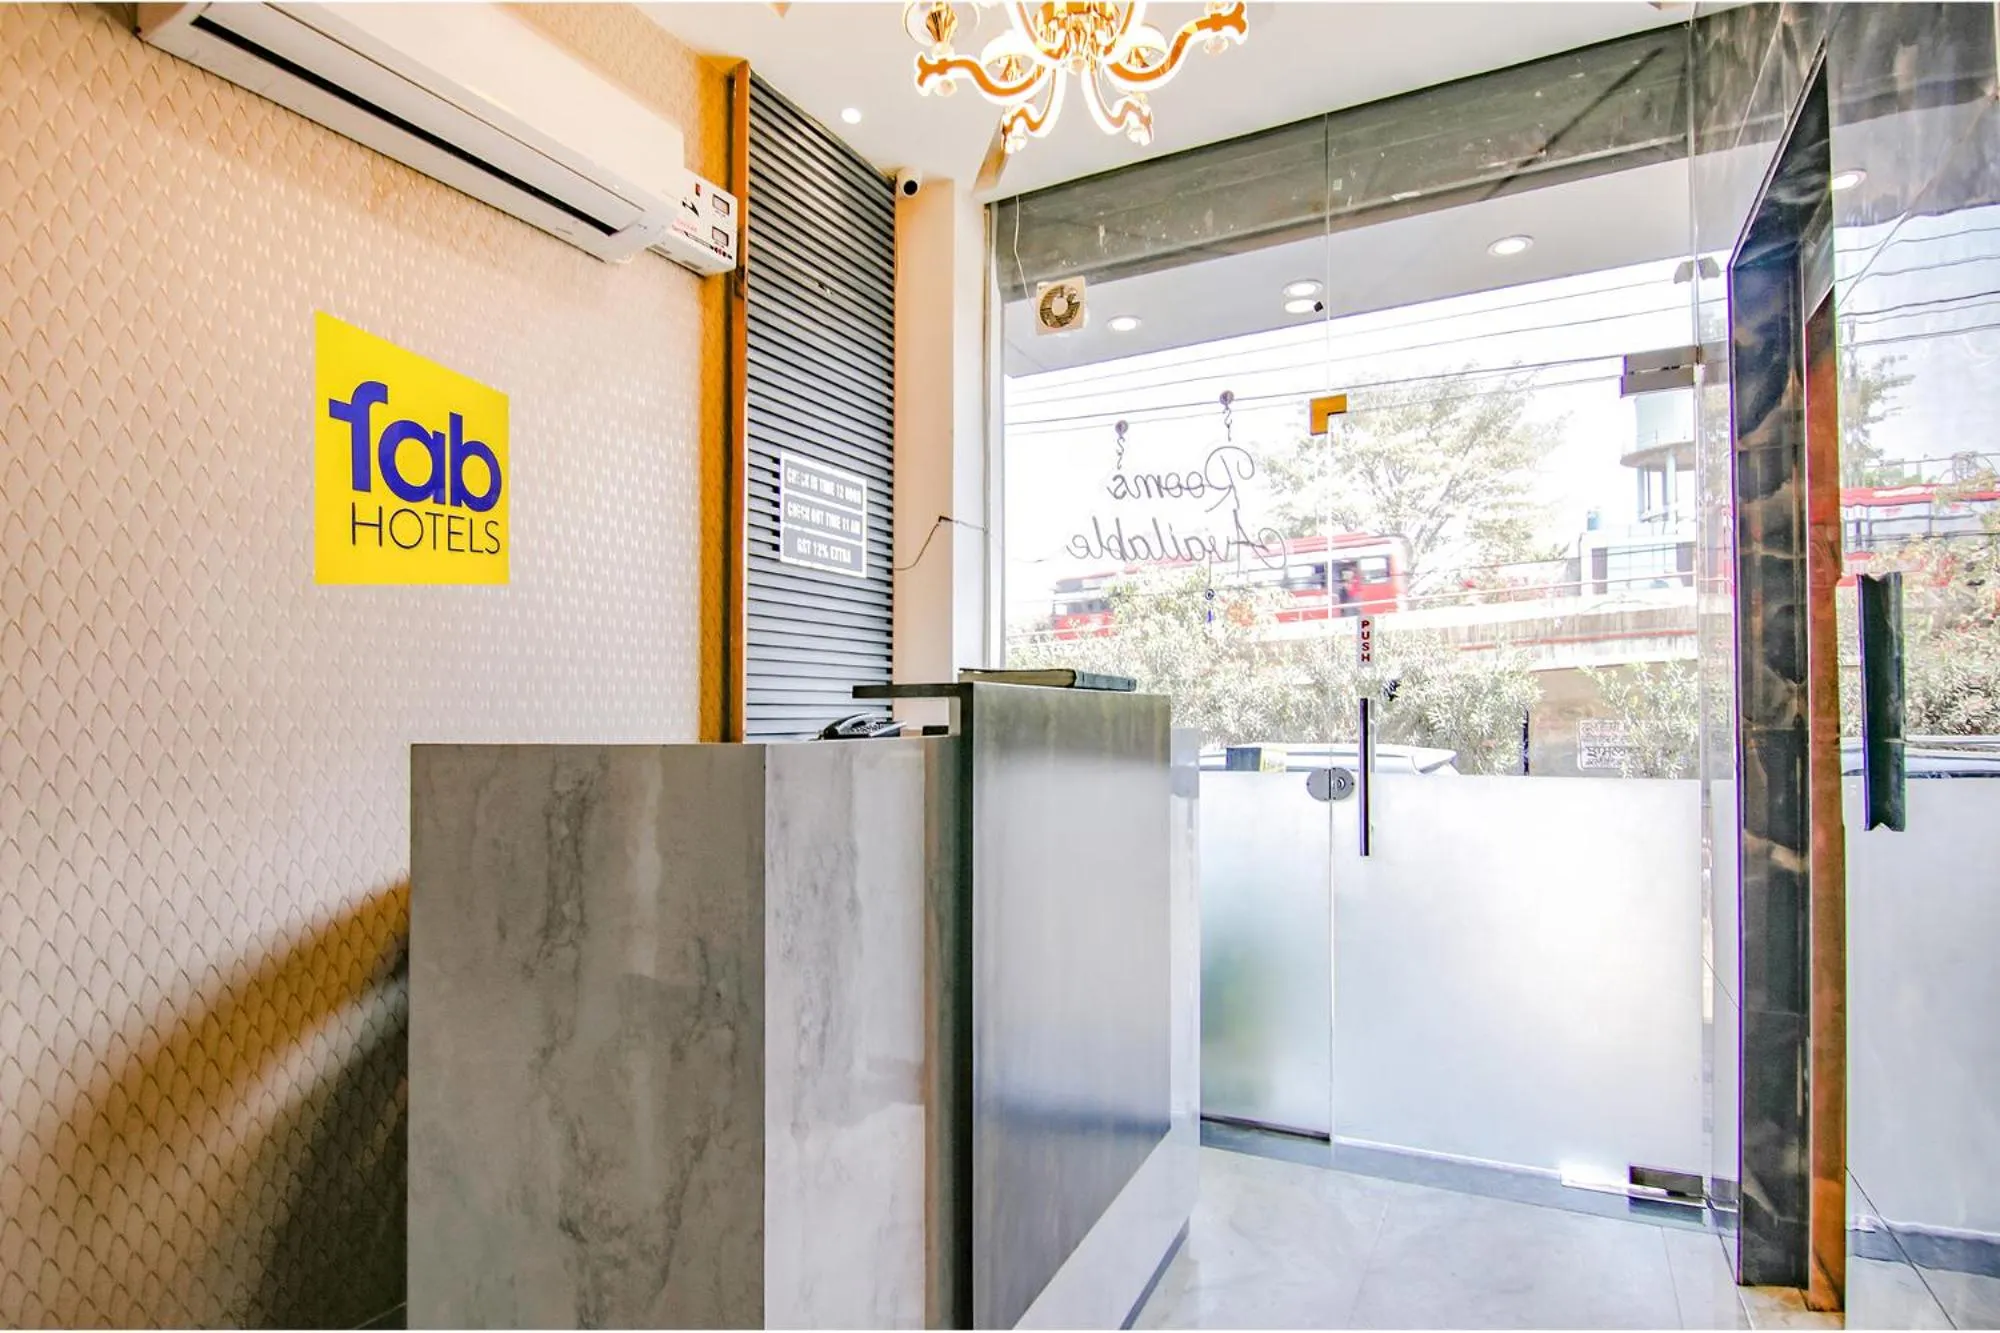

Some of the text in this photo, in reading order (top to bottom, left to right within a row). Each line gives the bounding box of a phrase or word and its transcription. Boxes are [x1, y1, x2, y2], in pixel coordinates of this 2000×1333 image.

[328, 380, 502, 512] fab
[351, 502, 501, 555] HOTELS
[1361, 620, 1370, 662] PUSH
